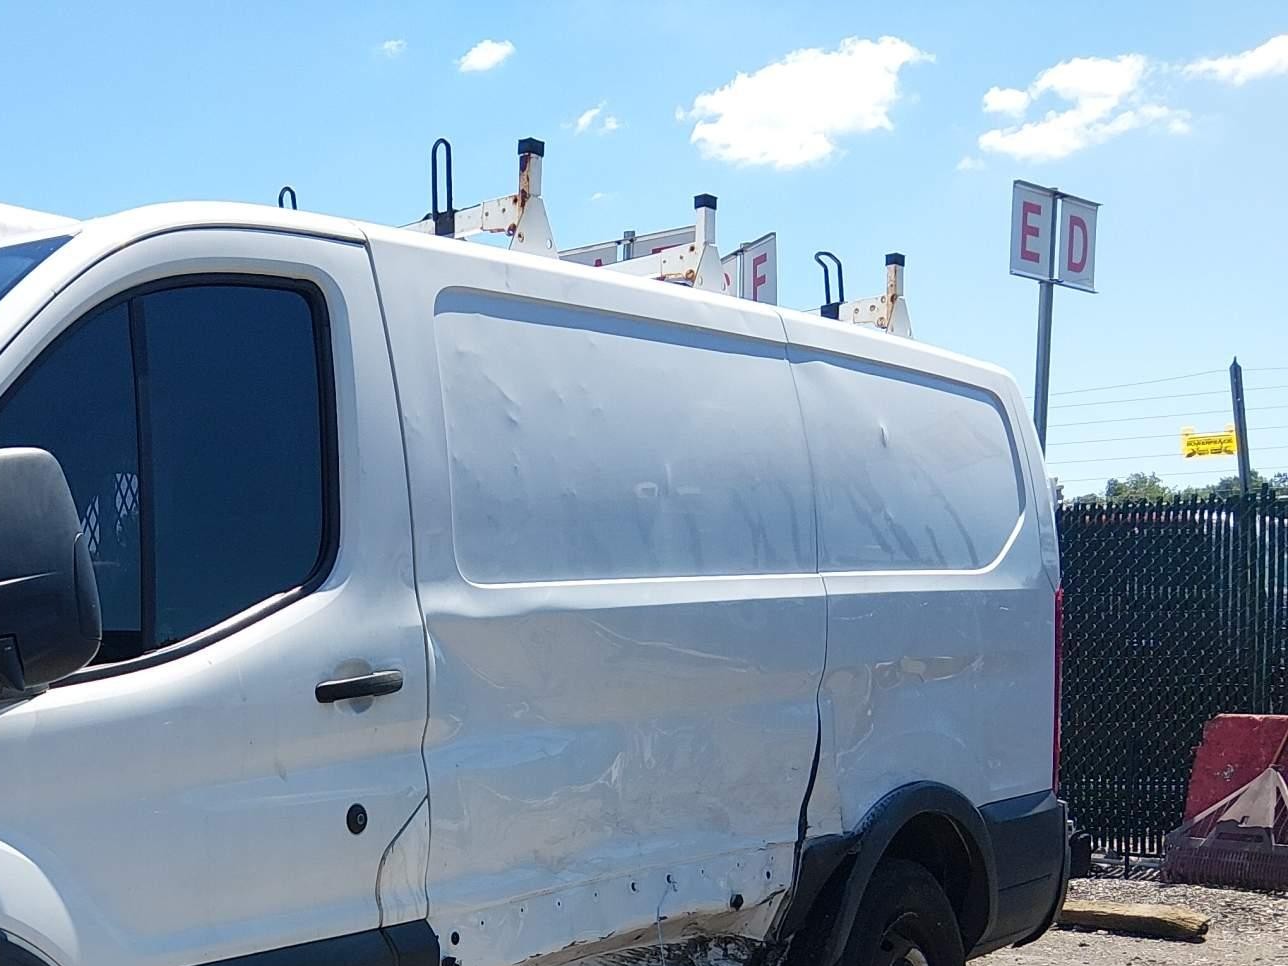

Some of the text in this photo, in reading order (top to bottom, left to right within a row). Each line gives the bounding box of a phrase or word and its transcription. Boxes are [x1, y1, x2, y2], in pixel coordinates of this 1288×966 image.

[1021, 200, 1088, 274] E D
[752, 252, 768, 302] F
